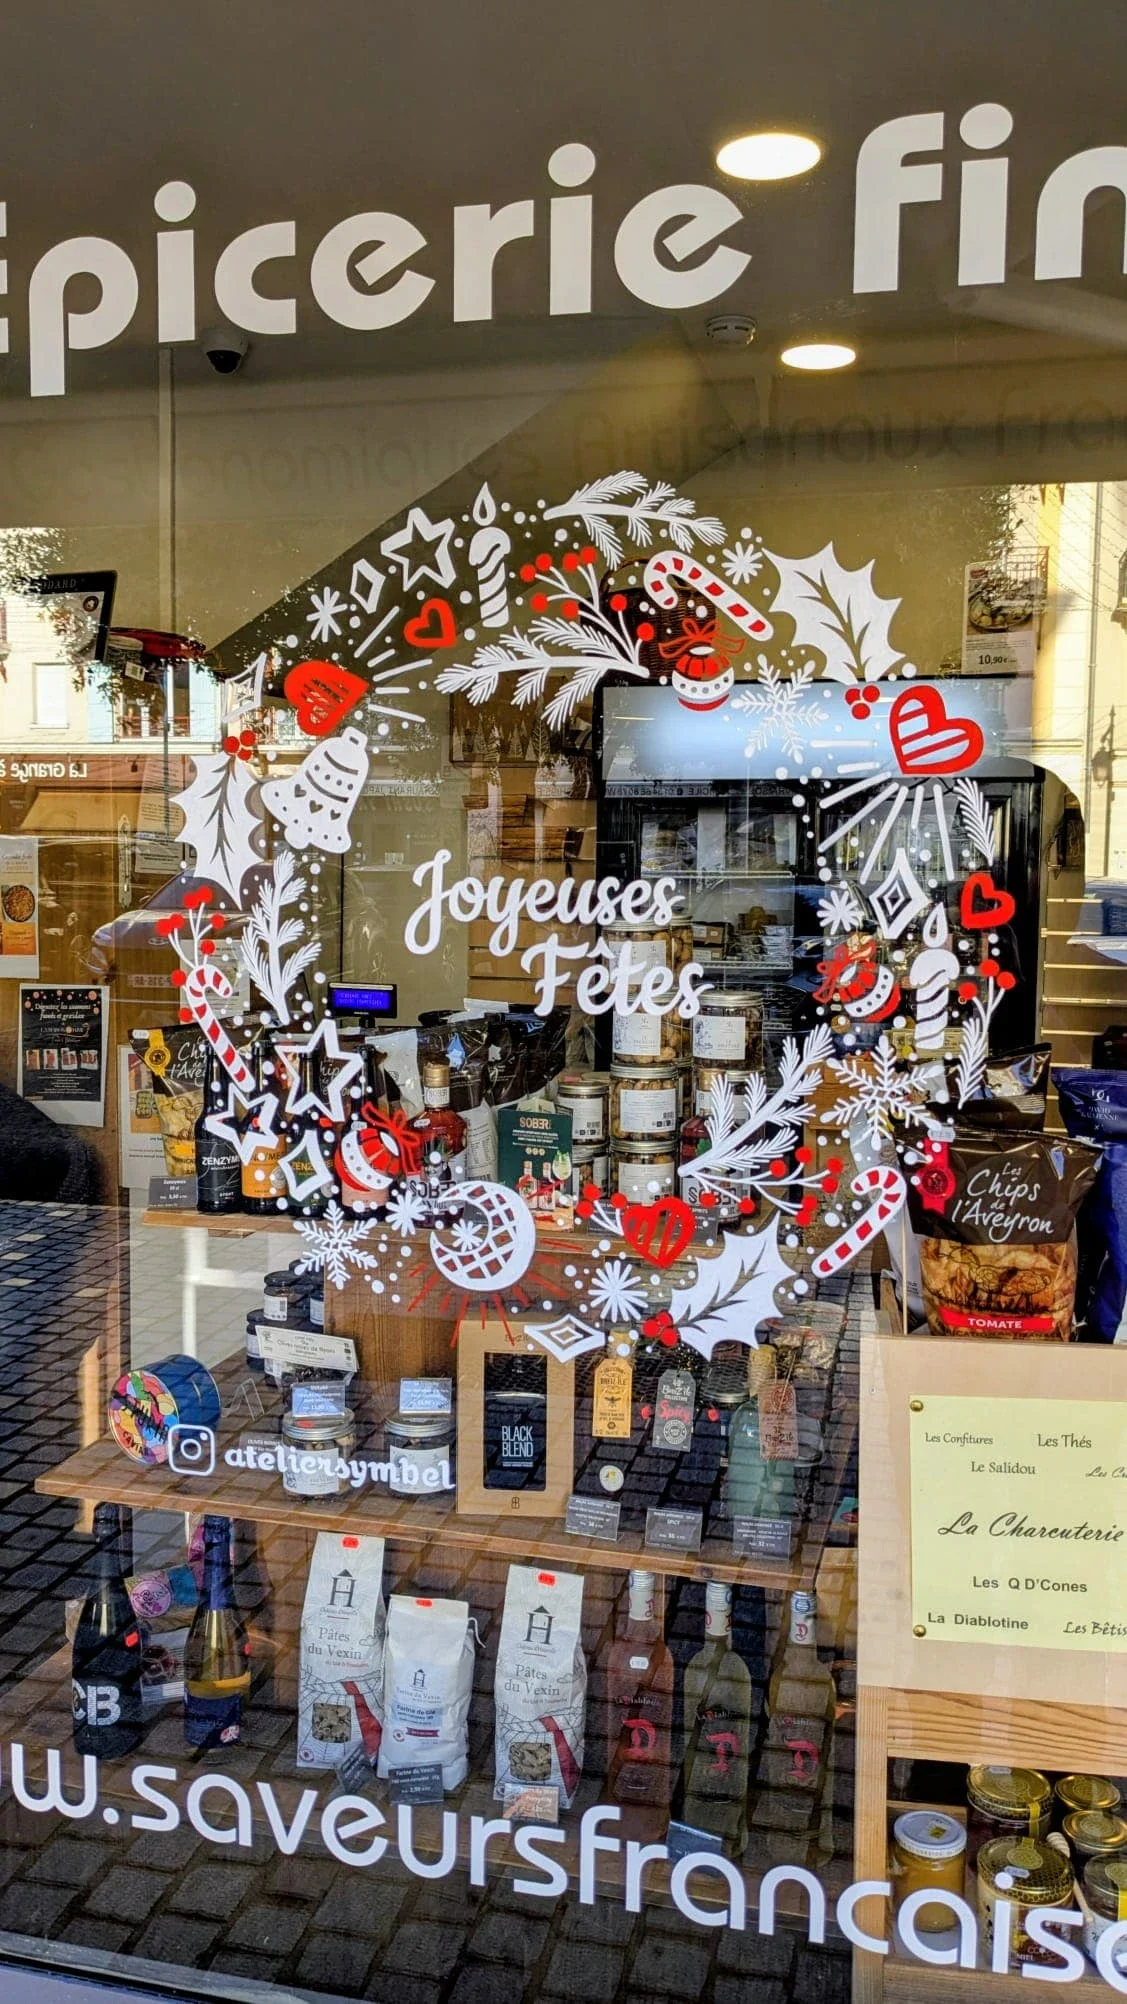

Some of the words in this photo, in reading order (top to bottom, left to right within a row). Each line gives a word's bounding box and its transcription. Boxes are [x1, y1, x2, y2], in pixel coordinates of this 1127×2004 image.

[0, 143, 751, 396] picerie
[404, 849, 685, 957] Joyeuses
[521, 933, 715, 1020] Fêtes
[519, 1116, 549, 1130] SOBER
[202, 1155, 240, 1166] ZENZYM
[1001, 1162, 1022, 1176] Les
[967, 1169, 1041, 1206] Chips
[990, 1201, 1005, 1211] de
[951, 1199, 1054, 1243] l'Aveyron
[968, 1317, 1023, 1329] TOMATE
[502, 1425, 534, 1442] BLACK
[925, 1431, 941, 1444] Les
[943, 1433, 994, 1448] Confitures
[1037, 1433, 1058, 1448] Les
[1061, 1433, 1092, 1449] Thés
[502, 1441, 534, 1458] BLEND
[224, 1443, 457, 1489] ateliersymbel
[971, 1460, 985, 1474] Le
[989, 1461, 1036, 1475] Salidou
[1085, 1466, 1107, 1479] Les
[937, 1511, 979, 1536] La
[988, 1511, 1124, 1542] Charcuterie
[972, 1576, 999, 1589] Les
[1008, 1577, 1020, 1591] Q
[1024, 1578, 1088, 1593] D'Cones
[927, 1612, 945, 1625] La
[953, 1613, 1029, 1631] Diablotine
[1063, 1622, 1087, 1635] Les
[320, 1626, 351, 1641] Pâtes
[307, 1642, 322, 1656] du
[327, 1643, 362, 1659] Vexin
[515, 1663, 548, 1681] Pâtes
[504, 1678, 521, 1693] du
[524, 1681, 560, 1697] Vexin
[0, 1744, 1127, 1993] w.saveursfrancais
